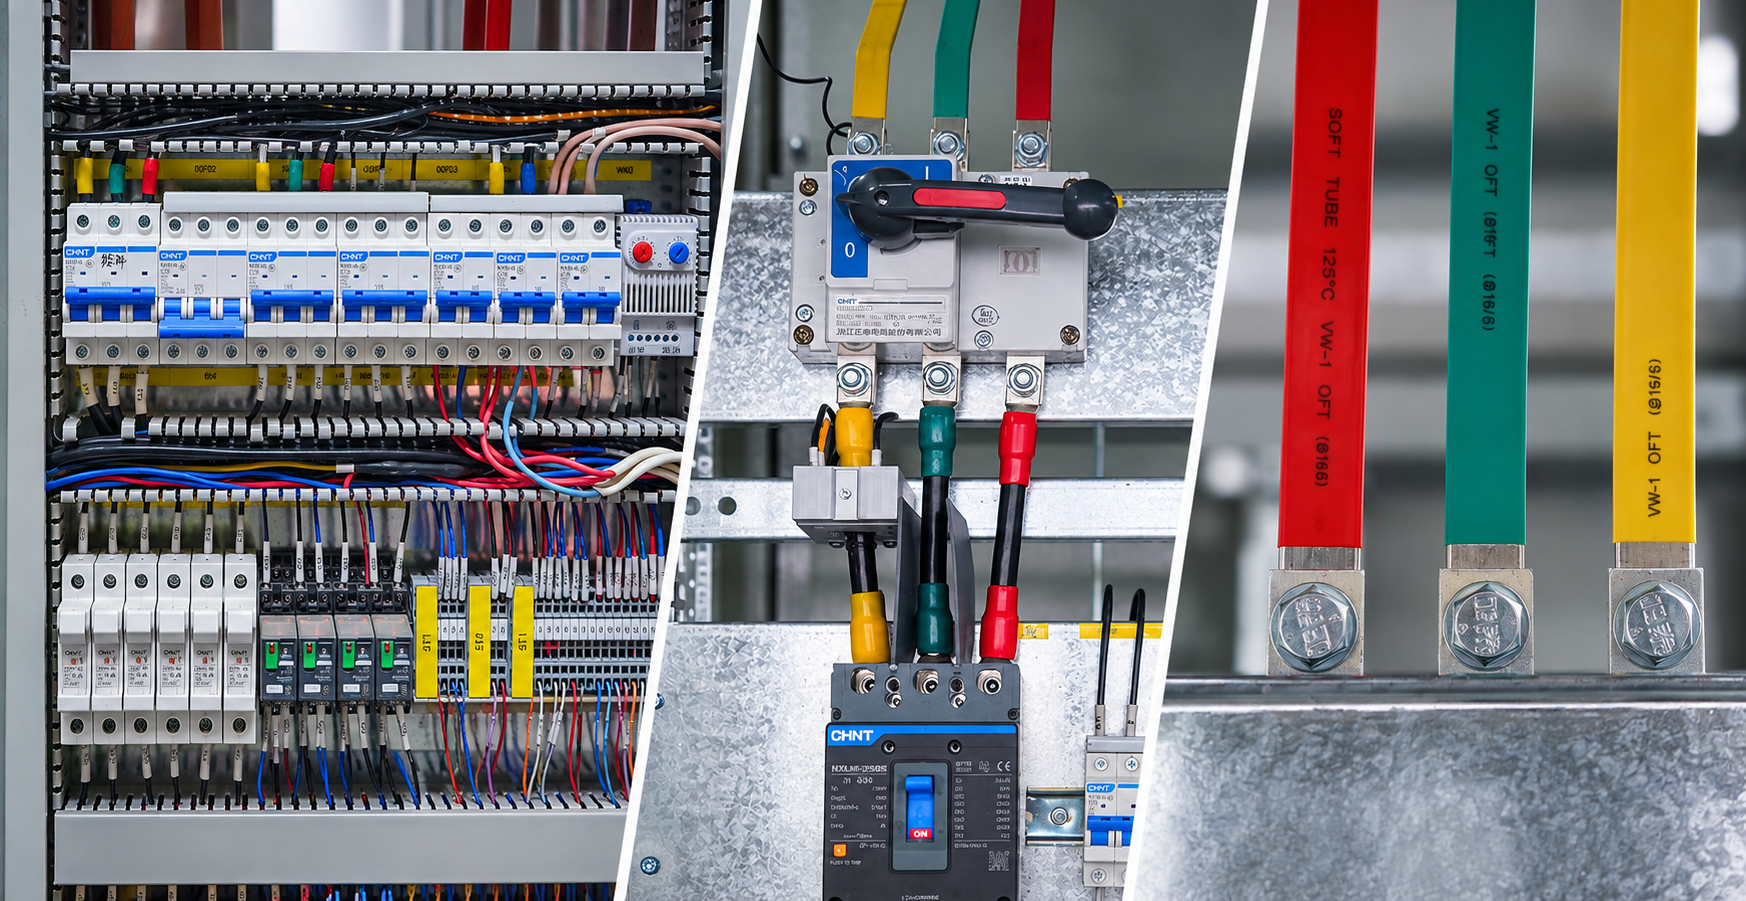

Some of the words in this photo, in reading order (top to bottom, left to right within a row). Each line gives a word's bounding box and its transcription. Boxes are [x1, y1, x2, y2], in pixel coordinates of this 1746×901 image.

[1327, 108, 1342, 157] SOFT
[1485, 108, 1499, 151] VW-1
[1324, 177, 1340, 228] TUBE
[1321, 247, 1336, 300] 125°C
[1318, 321, 1333, 369] VW-1
[1647, 430, 1661, 464] OFT
[1648, 476, 1661, 517] VW-1
[830, 729, 874, 742] CHNT
[913, 830, 928, 838] ON
